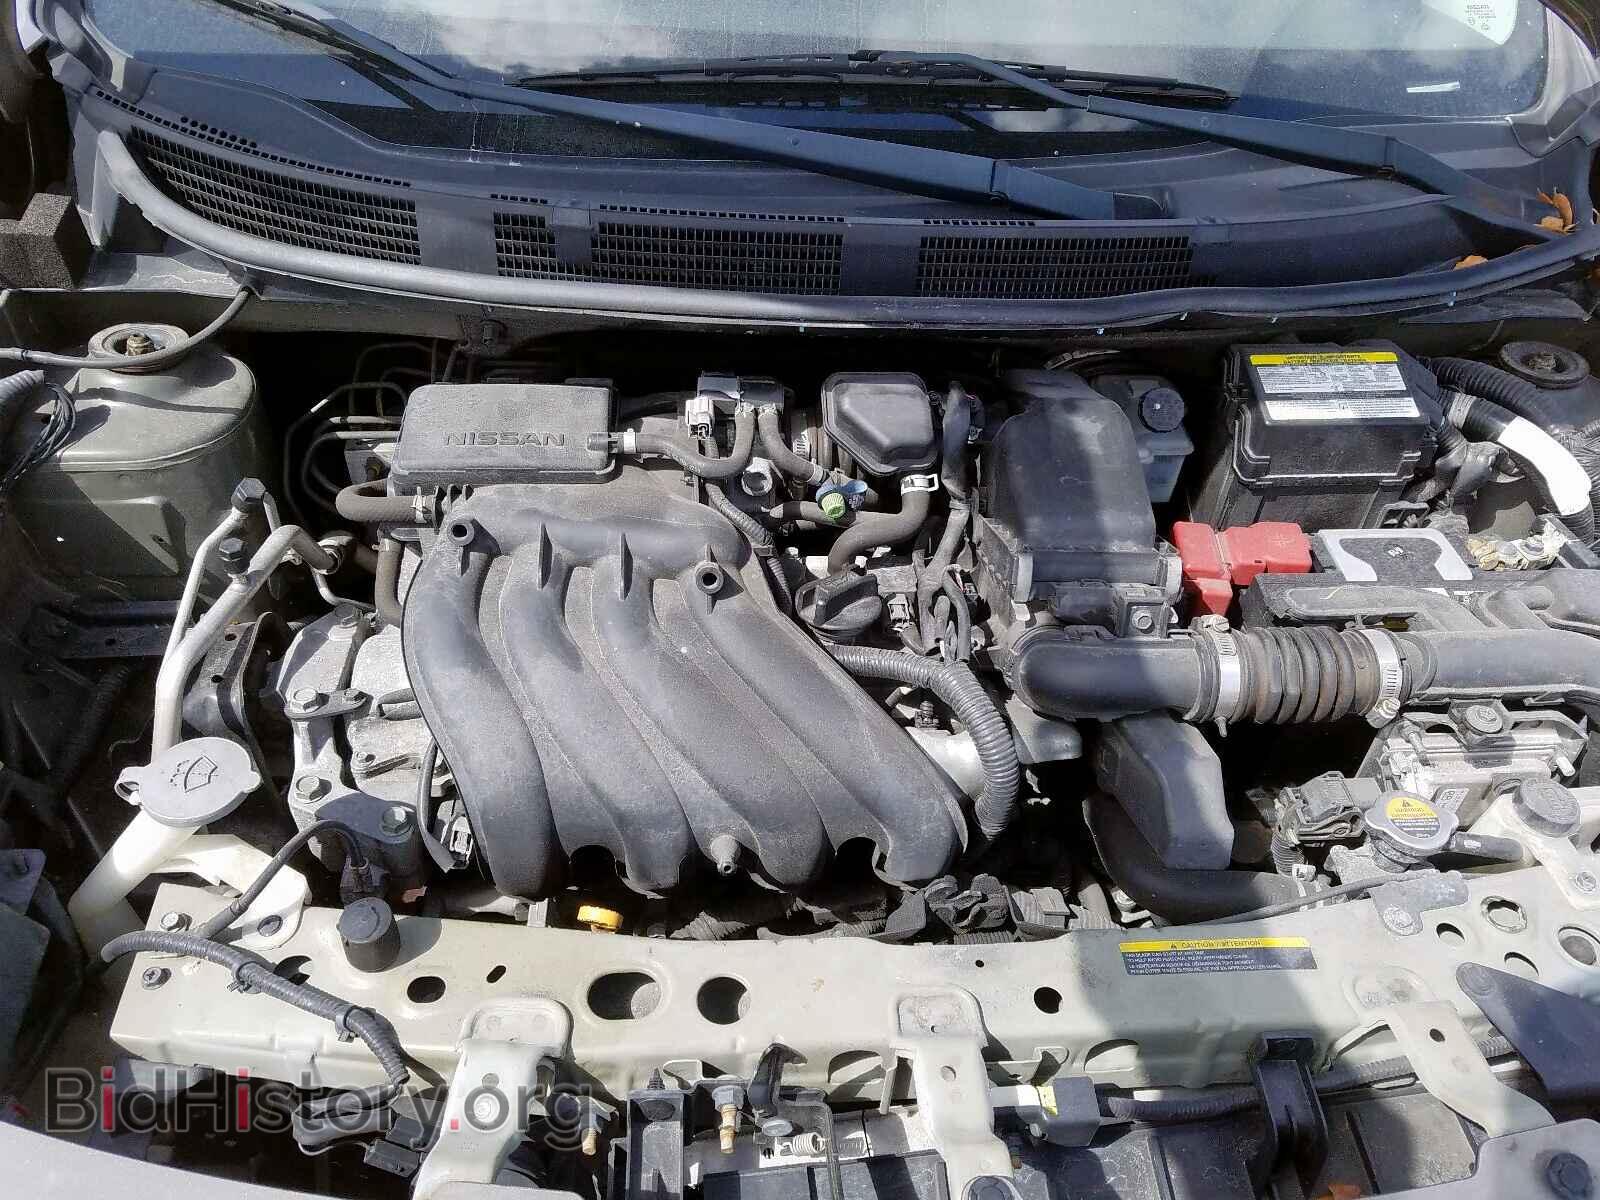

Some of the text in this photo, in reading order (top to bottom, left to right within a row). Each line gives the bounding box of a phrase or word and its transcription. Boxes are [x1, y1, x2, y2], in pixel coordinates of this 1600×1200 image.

[446, 431, 566, 446] NISSAN
[1181, 941, 1215, 949] CAUTION
[1222, 939, 1261, 948] ATTENTION
